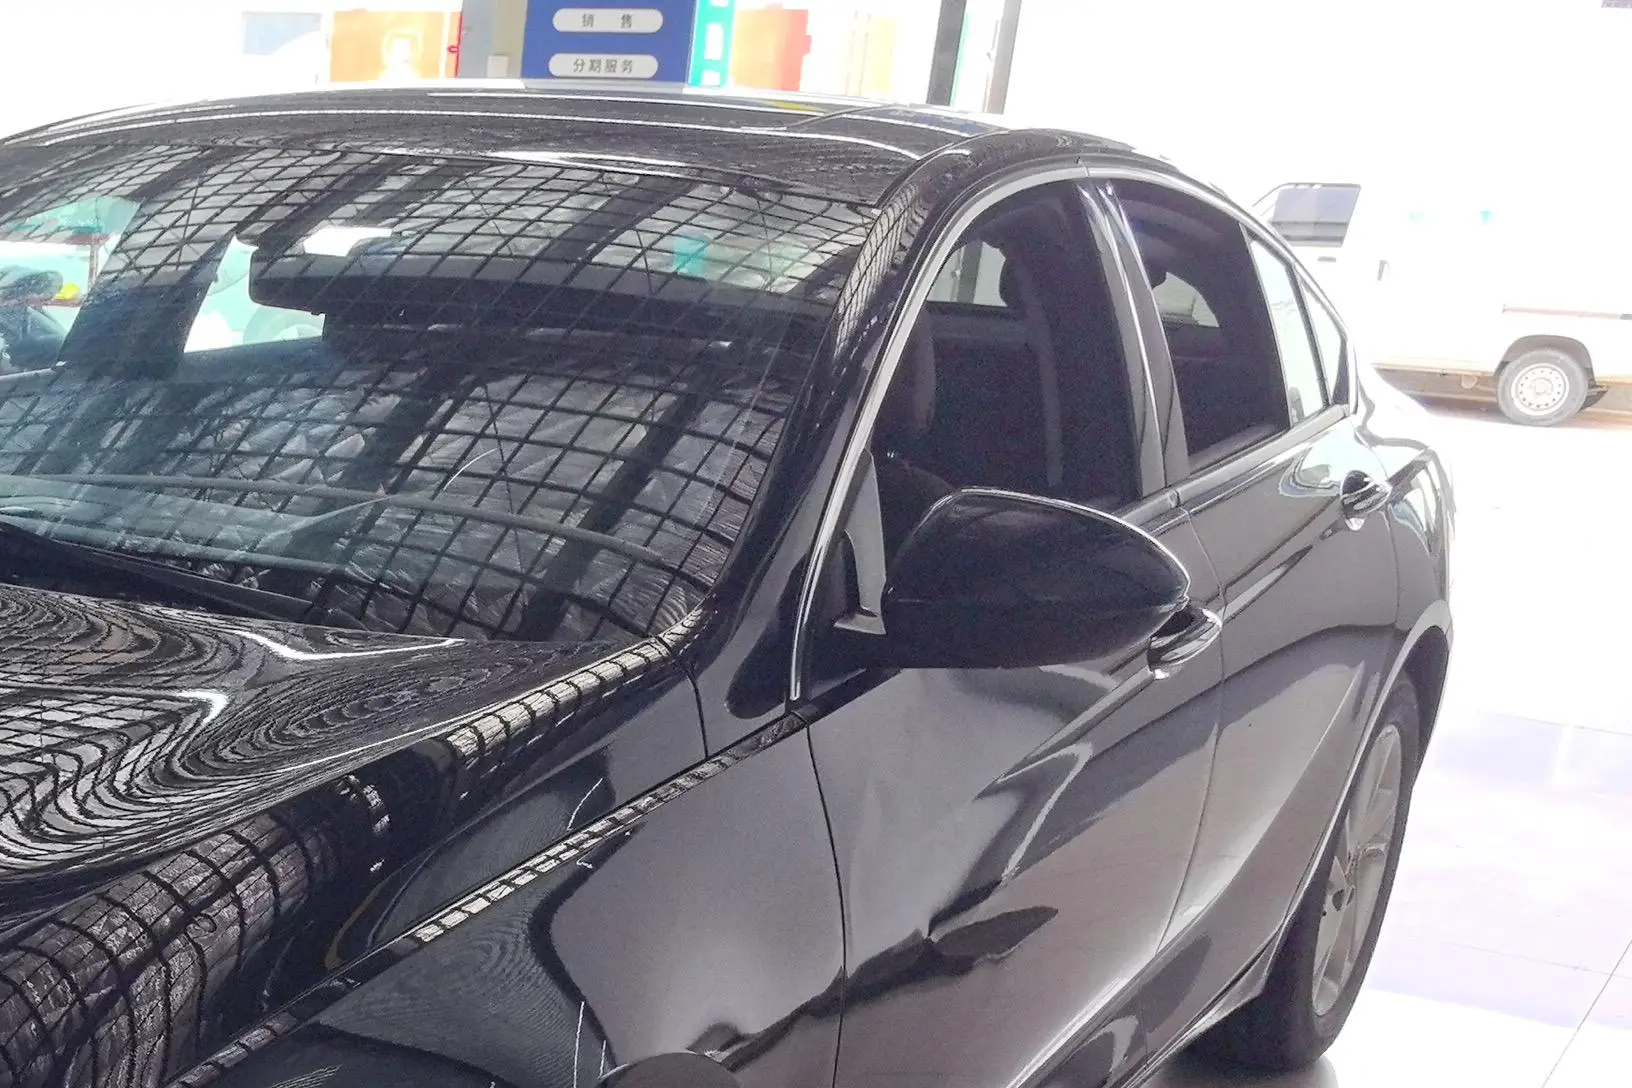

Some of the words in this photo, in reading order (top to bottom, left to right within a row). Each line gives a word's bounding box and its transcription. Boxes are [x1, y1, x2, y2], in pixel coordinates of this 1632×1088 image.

[581, 13, 633, 29] 销售
[572, 59, 634, 74] 分期服务
